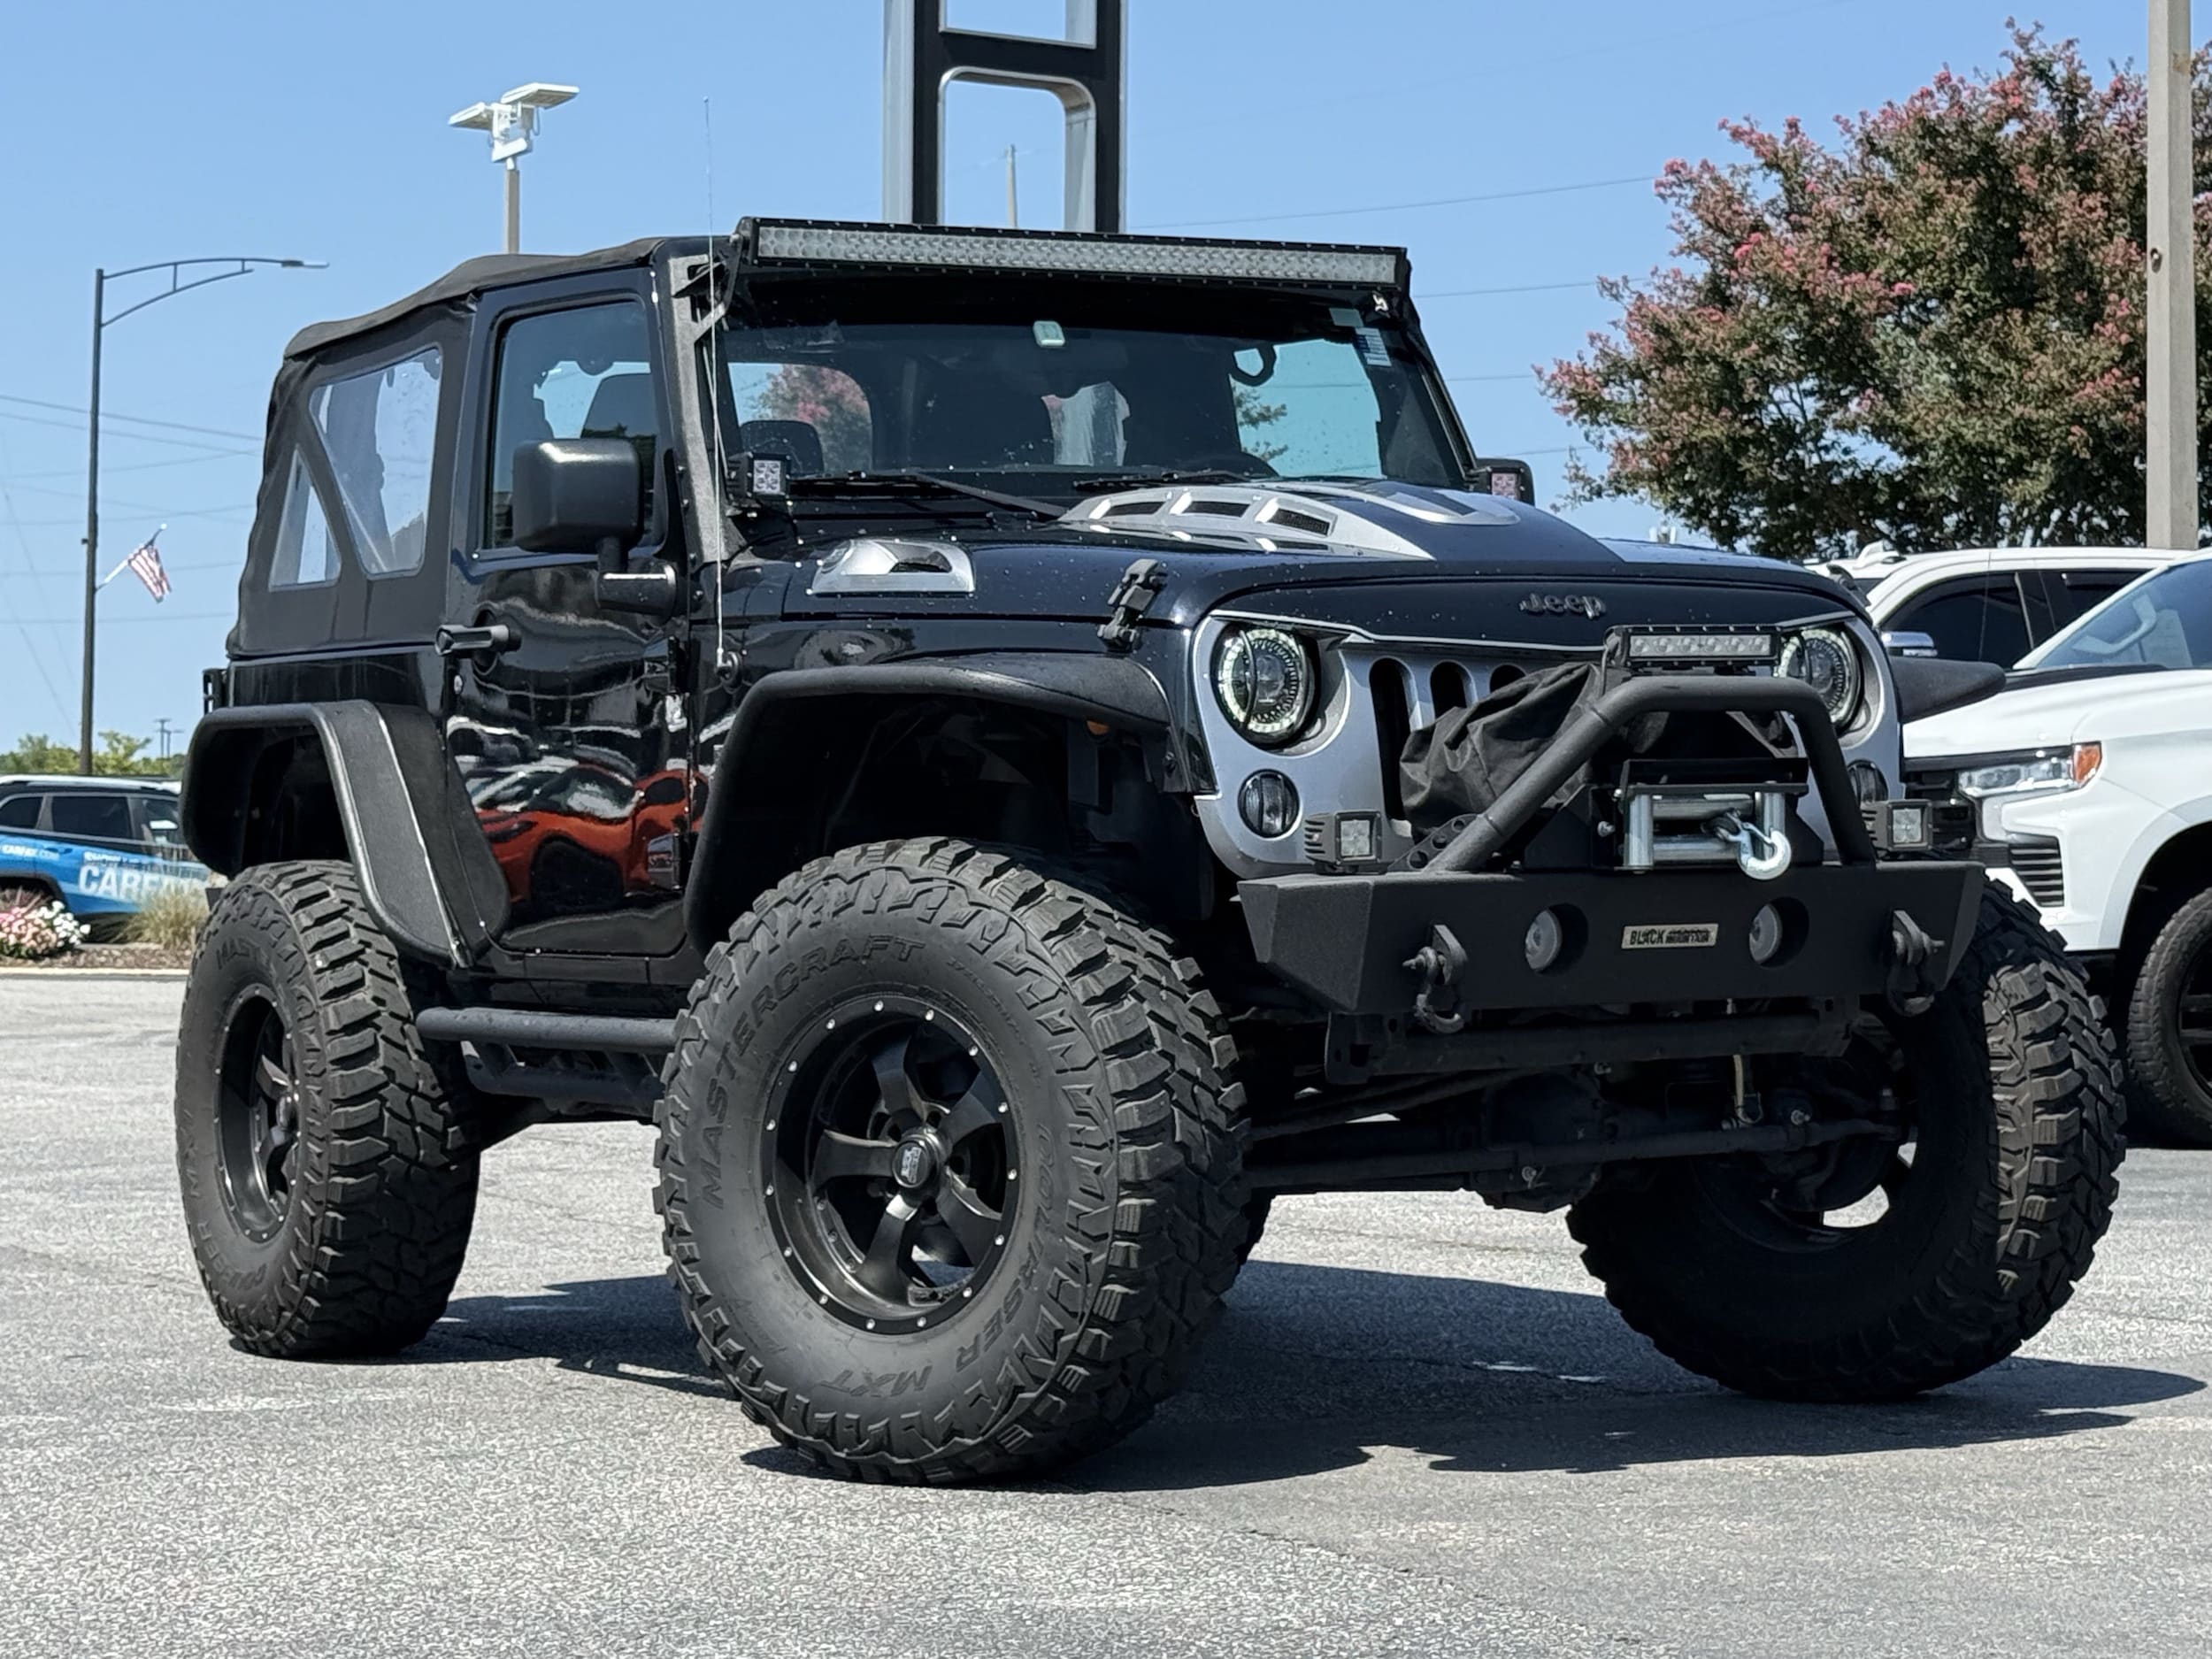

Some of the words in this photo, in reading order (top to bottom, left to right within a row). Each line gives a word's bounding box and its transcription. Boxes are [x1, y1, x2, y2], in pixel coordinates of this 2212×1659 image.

[1518, 592, 1606, 619] Jeep
[1630, 929, 1665, 945] BLACK
[700, 934, 927, 1210] MASTERCRAFT
[817, 1363, 933, 1398] MXT
